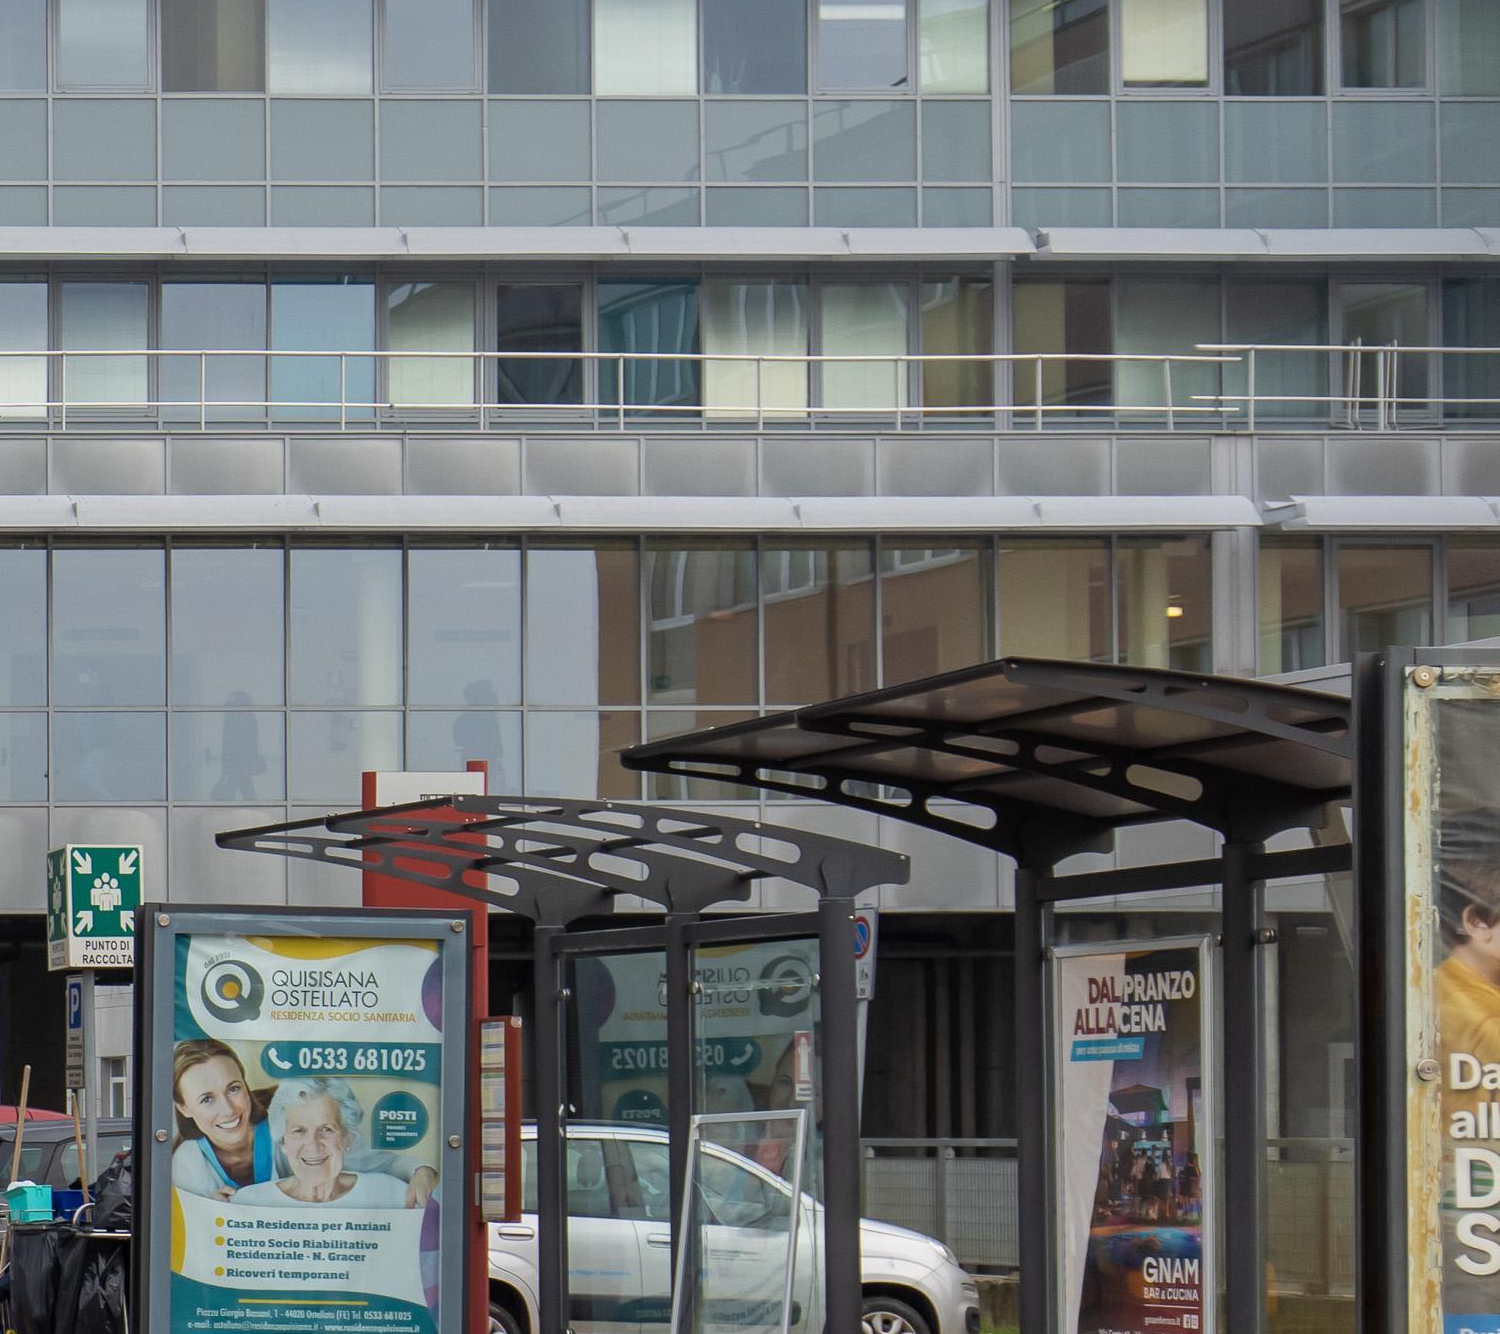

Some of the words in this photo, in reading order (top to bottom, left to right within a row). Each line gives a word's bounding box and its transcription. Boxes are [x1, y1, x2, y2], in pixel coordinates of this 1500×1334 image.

[85, 940, 118, 951] PUNTO
[120, 940, 130, 951] DI
[82, 954, 133, 964] RACCOLTA
[272, 969, 379, 988] QUISISANA
[1088, 976, 1122, 1004] DAL
[1123, 970, 1196, 1003] PRANZO
[271, 989, 379, 1008] OSTELLATO
[271, 1010, 324, 1021] RESIDENZA
[328, 1011, 360, 1022] SOCIO
[363, 1012, 417, 1023] SANITARIA
[1074, 1007, 1118, 1035] ALLA
[1120, 1004, 1167, 1033] CENA
[299, 1048, 348, 1070] 0533
[354, 1048, 426, 1071] 681025
[380, 1110, 417, 1120] POSTI
[226, 1219, 254, 1229] Casa
[256, 1220, 319, 1231] Residenza
[321, 1221, 342, 1232] per
[345, 1222, 391, 1232] Anziani
[226, 1237, 266, 1248] Centro
[268, 1238, 300, 1249] Socio
[302, 1239, 379, 1250] Riabilitativo
[226, 1250, 304, 1261] Residenziale
[312, 1252, 326, 1261] N.
[328, 1251, 366, 1262] Gracer
[226, 1268, 276, 1278] Ricoveri
[278, 1269, 349, 1281] temporanei
[1143, 1256, 1199, 1285] GNAM
[1143, 1287, 1160, 1299] BAR
[1167, 1288, 1199, 1301] CUCINA
[196, 1307, 218, 1317] Piazza
[220, 1308, 245, 1319] Giorgio
[306, 1310, 334, 1319] Ostellato
[336, 1310, 350, 1321] (FE)
[364, 1311, 382, 1320] 0533
[384, 1311, 412, 1321] 681025
